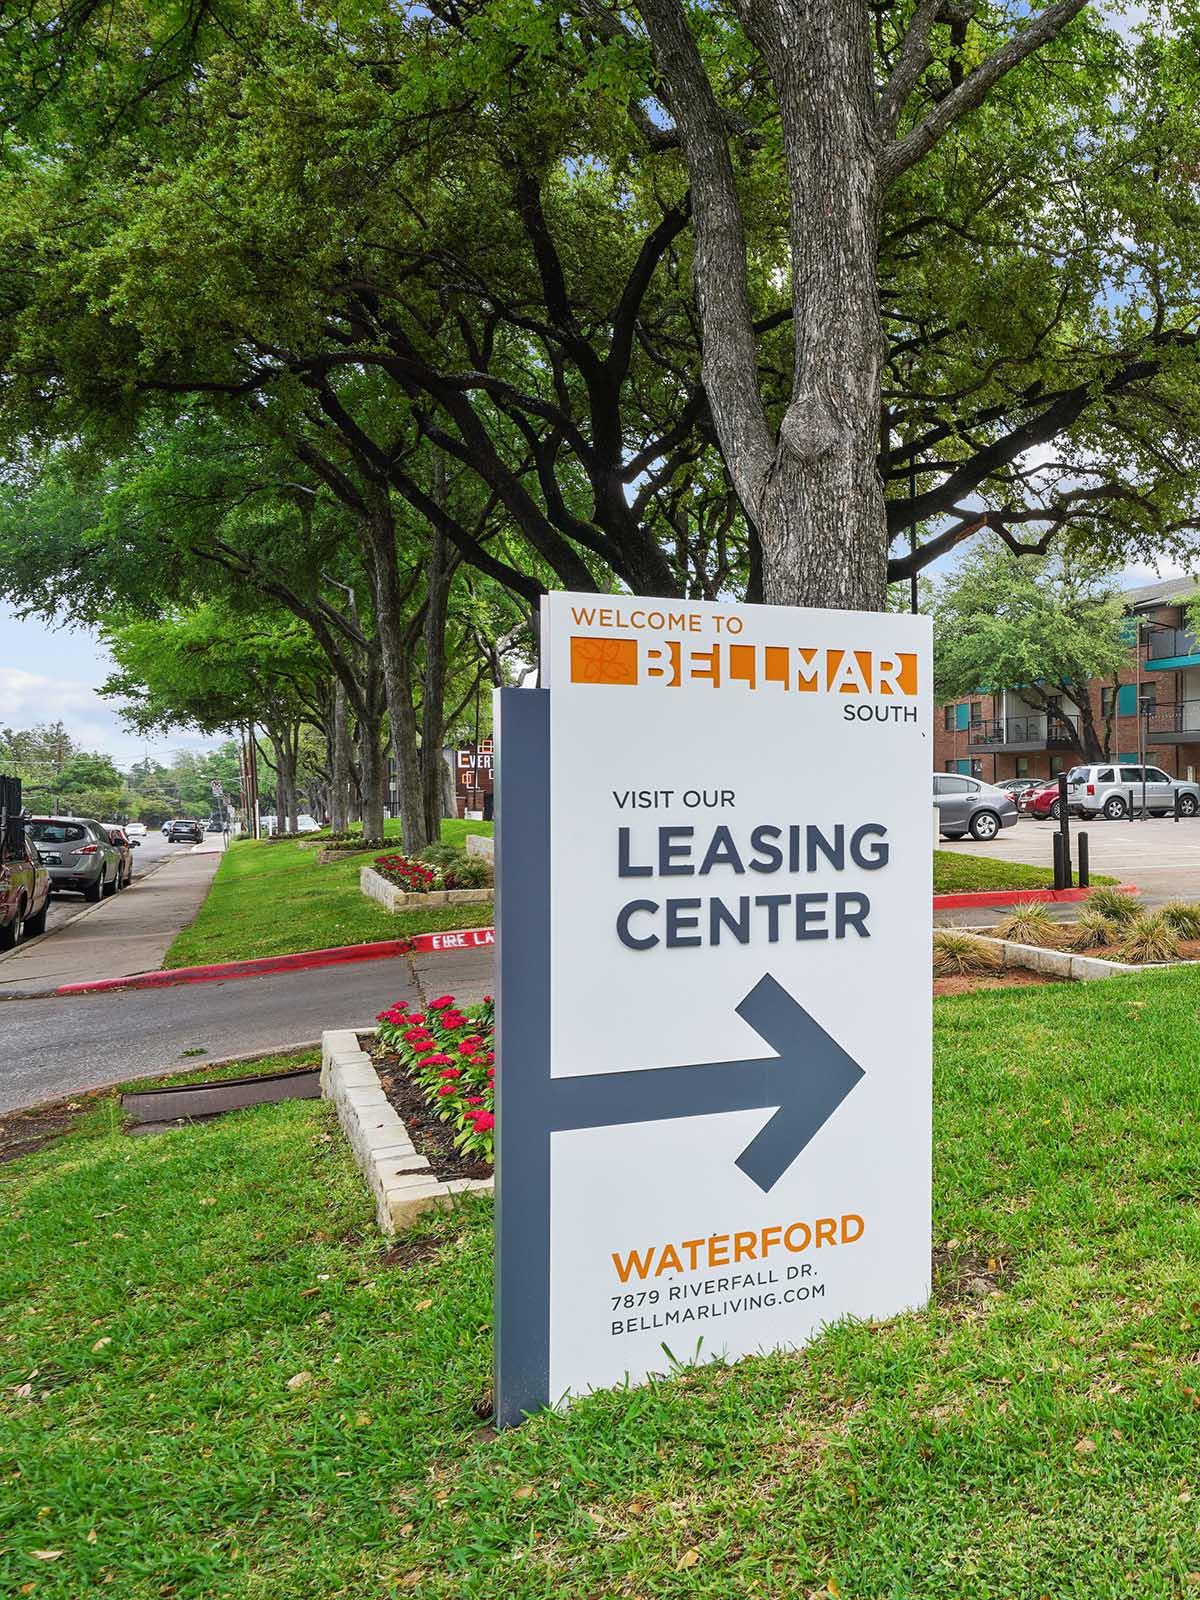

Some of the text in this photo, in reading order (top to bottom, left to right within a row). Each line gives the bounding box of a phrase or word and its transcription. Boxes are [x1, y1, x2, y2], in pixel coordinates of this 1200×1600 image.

[570, 607, 744, 635] WELCOME TO
[638, 640, 917, 697] BELLMAR
[842, 703, 918, 723] SOUTH
[612, 790, 736, 809] VISIT OUR
[618, 823, 890, 878] LEASING
[473, 931, 496, 944] LA
[616, 892, 871, 951] CENTER
[611, 1214, 864, 1283] WATERFORD
[611, 1263, 818, 1312] 7879 RIVERFALL DR.
[611, 1284, 826, 1336] BELLMARLIVING.COM
